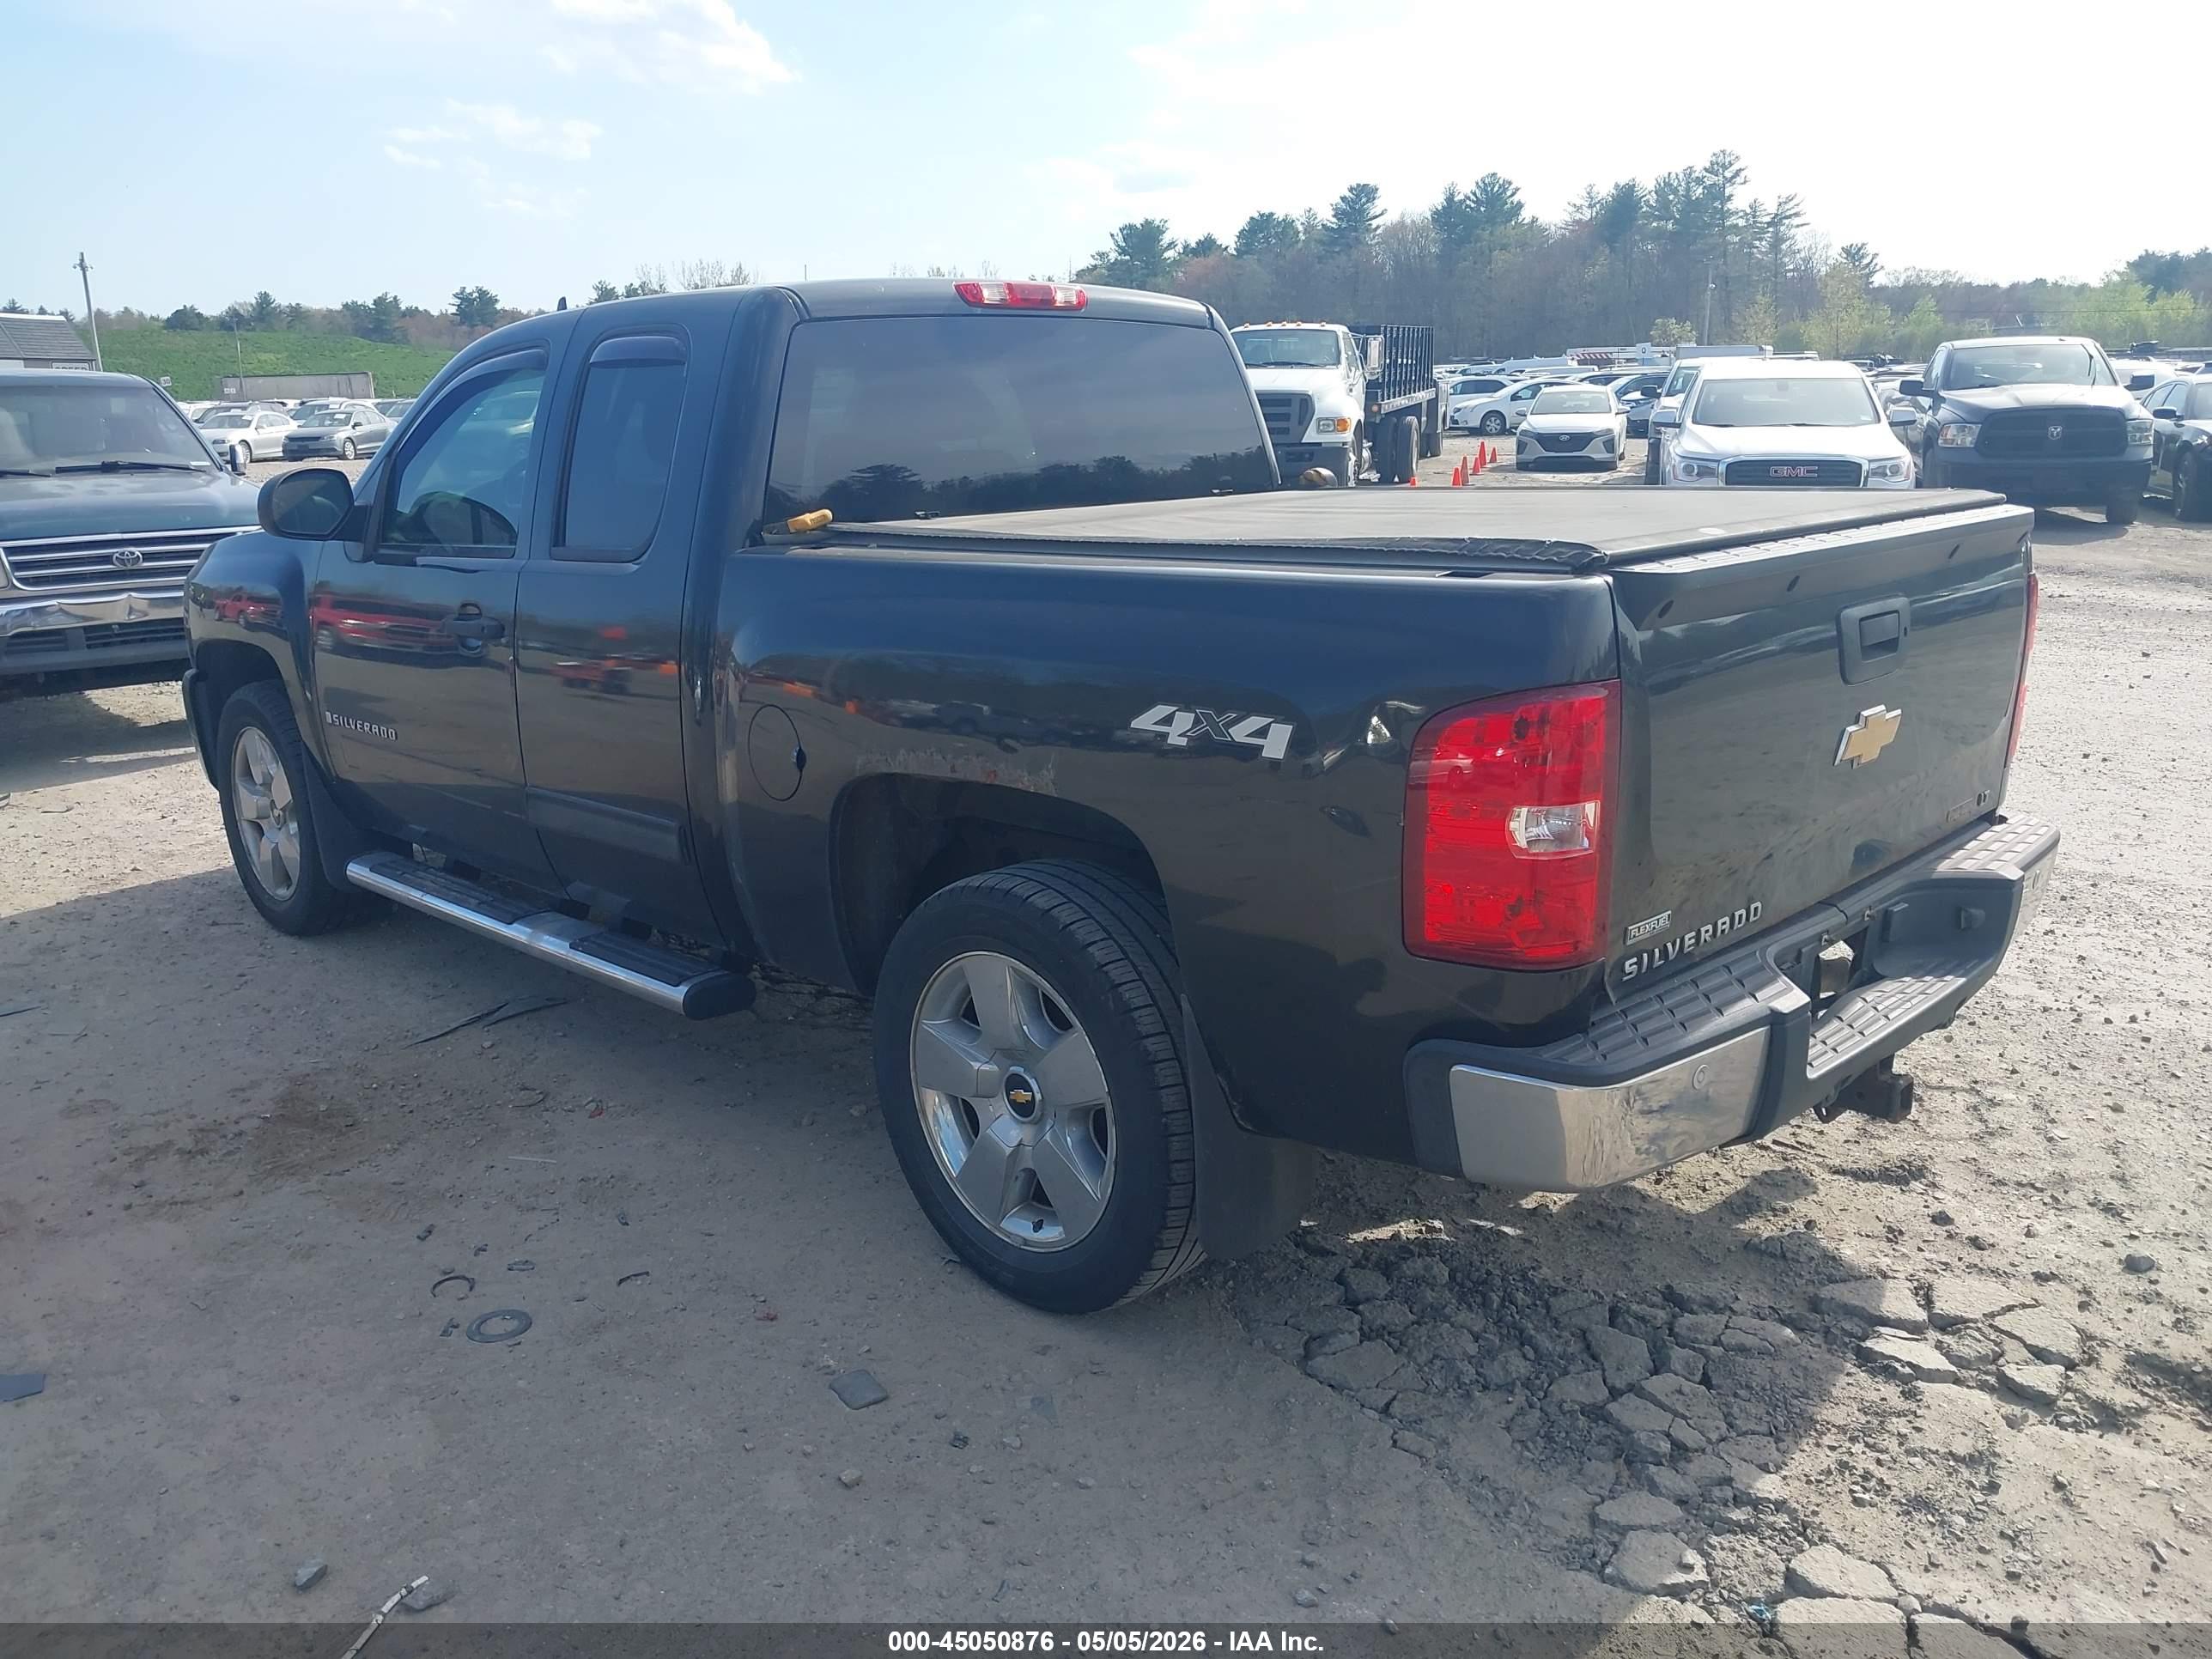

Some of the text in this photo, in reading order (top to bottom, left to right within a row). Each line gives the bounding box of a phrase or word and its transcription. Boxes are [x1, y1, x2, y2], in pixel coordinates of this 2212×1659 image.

[1770, 465, 1819, 477] GMC
[332, 714, 397, 740] SILVERADO
[1630, 914, 1670, 939] FLEXFUEL
[1621, 901, 1762, 981] SILVERADO
